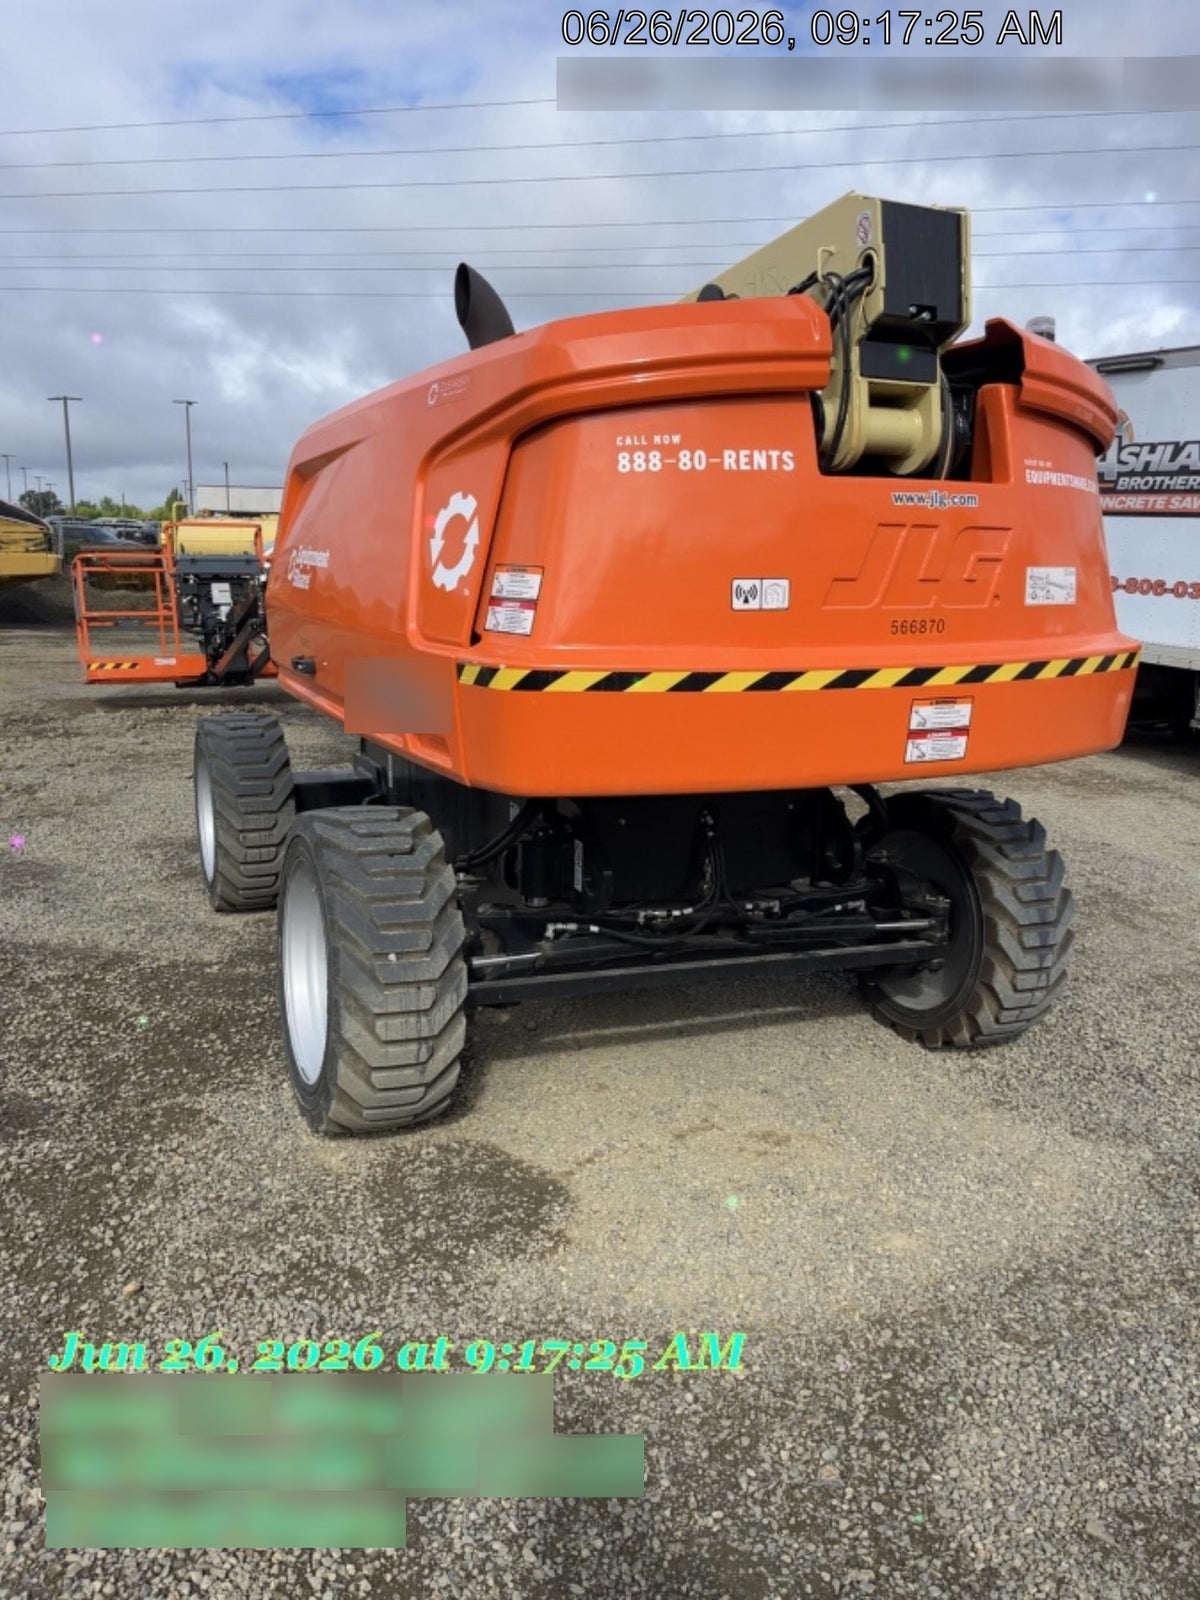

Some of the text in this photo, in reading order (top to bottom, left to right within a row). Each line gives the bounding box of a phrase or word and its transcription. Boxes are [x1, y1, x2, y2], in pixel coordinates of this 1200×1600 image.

[616, 434, 682, 446] CALL NOW
[617, 450, 795, 473] 888-80-RENTS
[1116, 475, 1200, 490] BROTHER
[891, 490, 979, 508] www.jlg.com
[1100, 495, 1167, 510] NCRETE
[821, 522, 1013, 610] JLG
[890, 618, 946, 635] 566870
